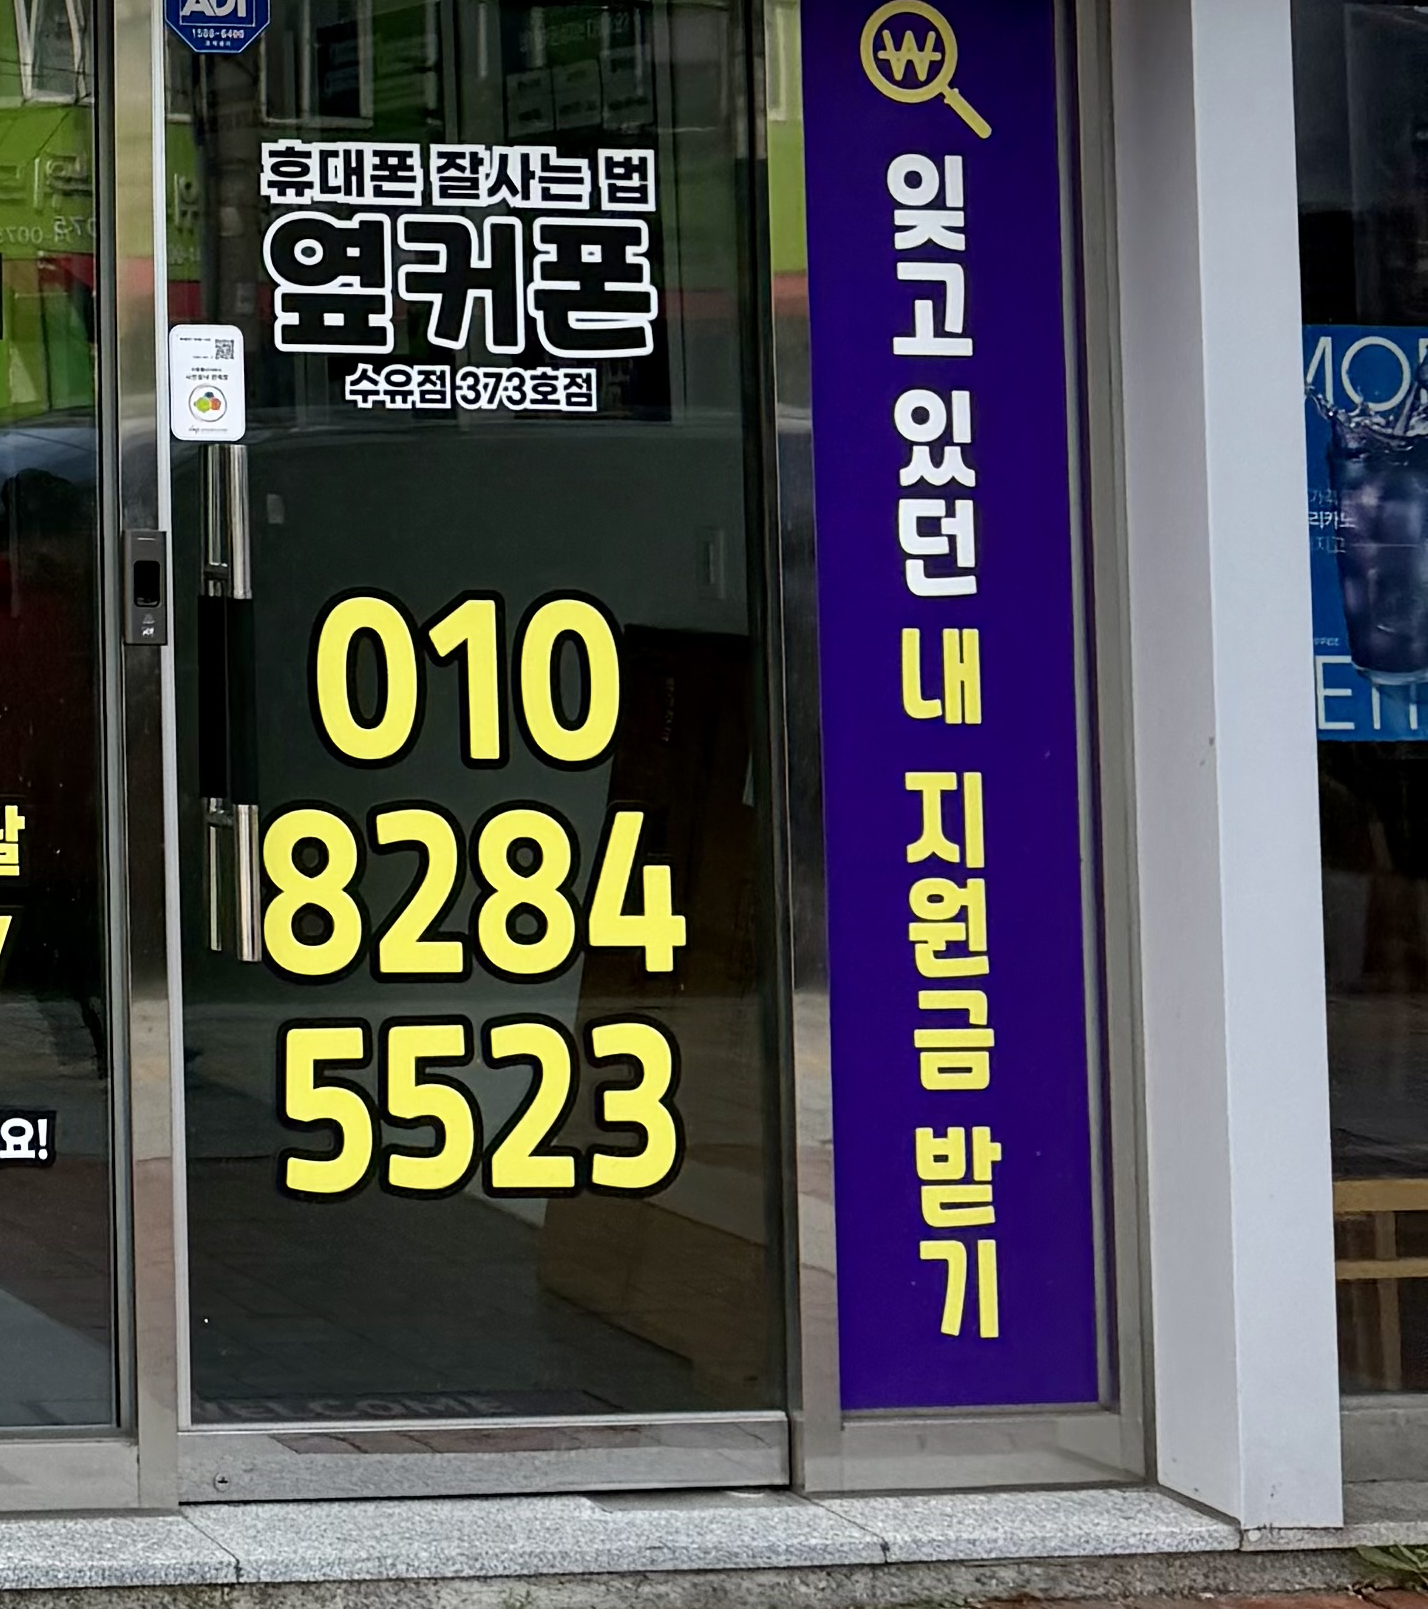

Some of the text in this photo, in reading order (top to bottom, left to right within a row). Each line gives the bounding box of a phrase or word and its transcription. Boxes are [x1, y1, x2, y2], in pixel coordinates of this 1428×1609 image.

[262, 140, 656, 211] 휴대폰 잘사는 법
[345, 363, 598, 412] 수유점 373호점
[315, 596, 620, 762] 010
[887, 153, 1002, 1339] 잊고 있던 내 지원금 받기
[263, 808, 686, 975] 8284
[285, 1022, 678, 1194] 5523
